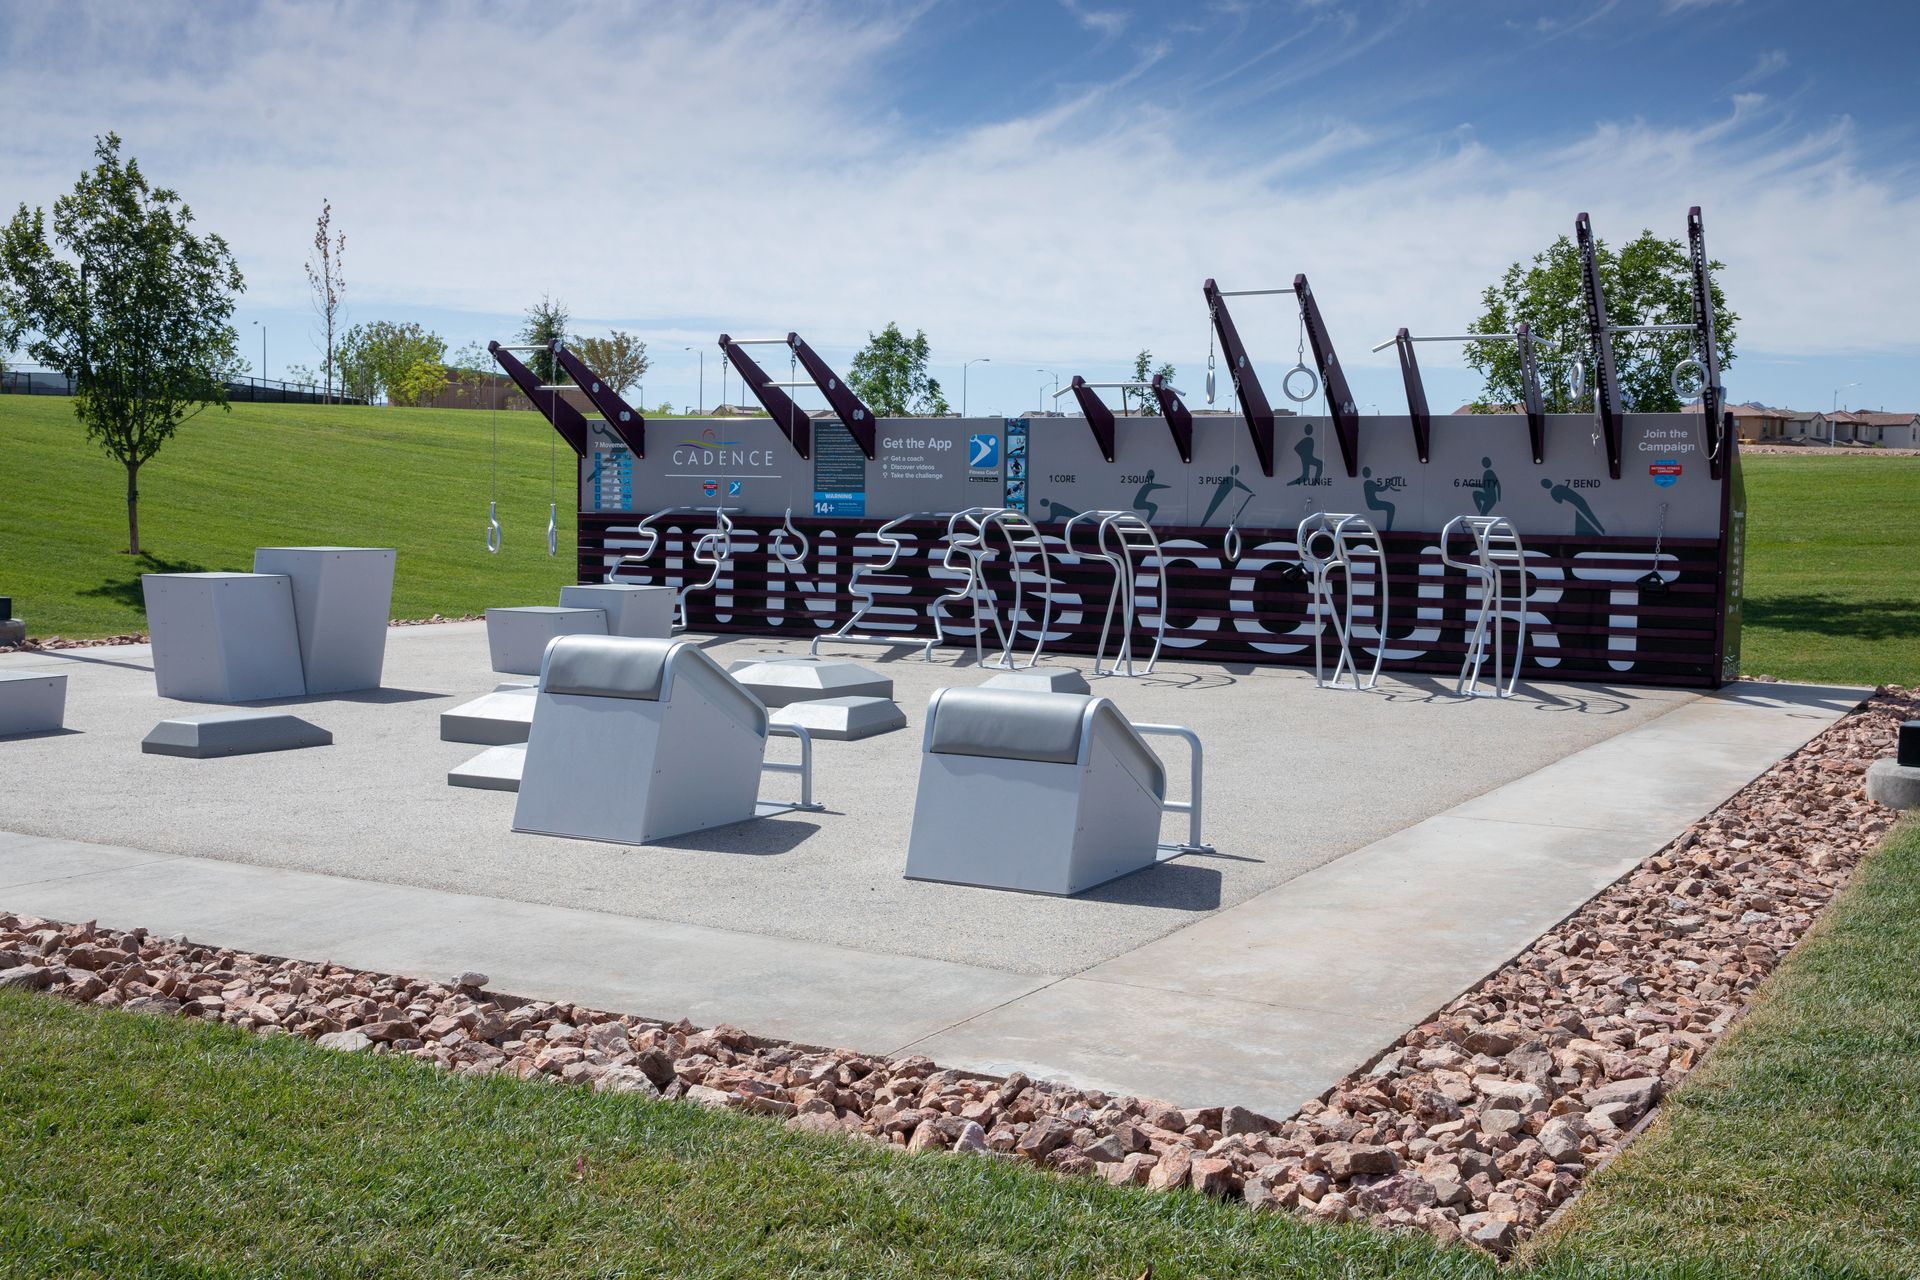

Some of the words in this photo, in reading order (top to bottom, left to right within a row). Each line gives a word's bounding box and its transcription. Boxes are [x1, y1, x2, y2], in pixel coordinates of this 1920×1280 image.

[1643, 429, 1667, 439] Join
[1669, 429, 1689, 439] the
[882, 437, 904, 449] Get
[906, 437, 926, 449] the
[928, 437, 952, 451] App
[1638, 442, 1695, 453] Campaign
[673, 450, 774, 466] CADENCE
[915, 472, 943, 480] challenge
[1054, 475, 1076, 483] CORE
[1120, 475, 1126, 484] 2
[1127, 475, 1154, 484] SQUAT
[1198, 476, 1204, 485] 3
[1205, 476, 1229, 485] PUSH
[1303, 477, 1333, 486] LUNGE
[1376, 478, 1383, 487] 5
[1385, 478, 1407, 487] PULL
[1453, 479, 1460, 488] 6
[1462, 479, 1499, 488] AGILITY
[1565, 479, 1571, 488] 7
[1573, 479, 1601, 488] BEND
[815, 502, 835, 514] 14+
[604, 526, 1081, 641] FITNESS
[1135, 539, 1681, 671] COURT
